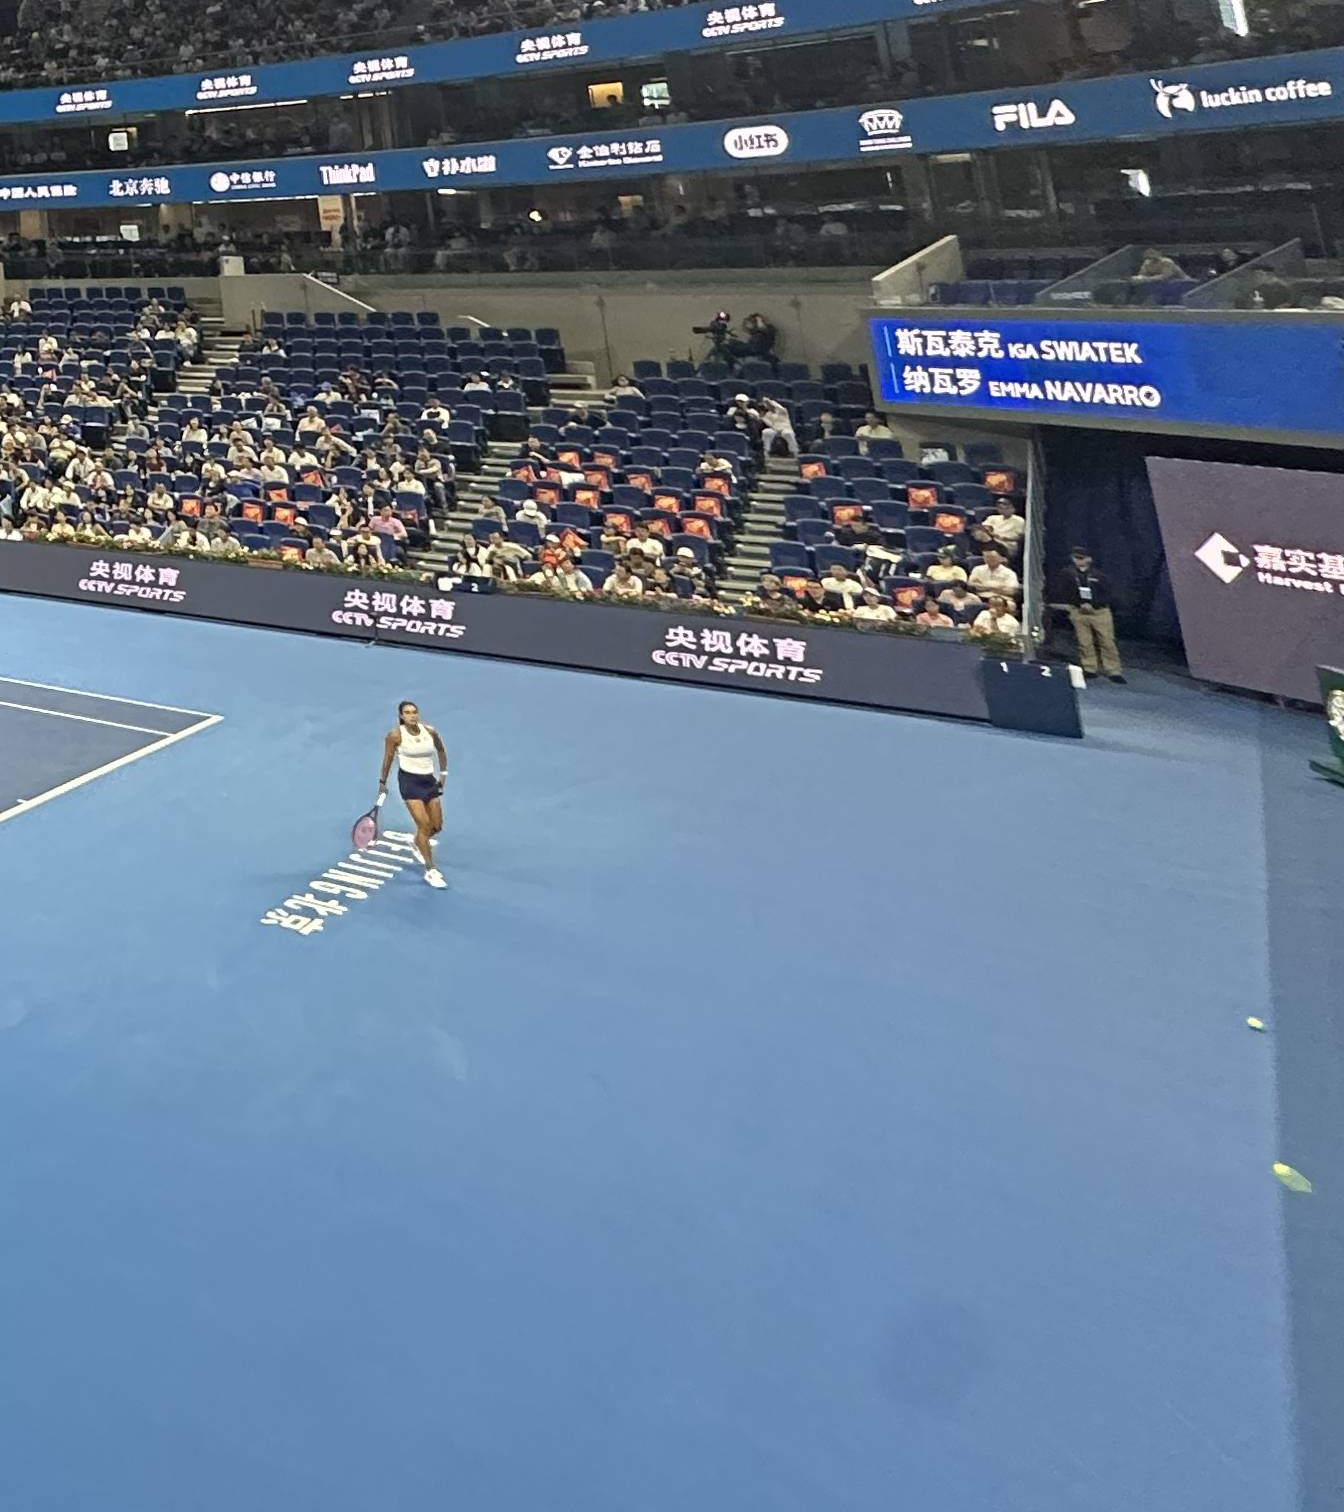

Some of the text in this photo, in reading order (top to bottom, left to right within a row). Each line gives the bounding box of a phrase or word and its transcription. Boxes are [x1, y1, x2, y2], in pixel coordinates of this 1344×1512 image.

[1200, 80, 1331, 107] luckin coffee
[992, 100, 1075, 131] FILA
[320, 163, 375, 184] ThinkPad
[896, 328, 1142, 365] 斯瓦泰克 IGA SWIATEK
[903, 367, 1162, 408] 纳瓦罗 EMMA NAVARRO
[90, 560, 180, 587] 央视体育
[471, 582, 479, 592] 2
[1257, 572, 1334, 594] Harvest
[78, 579, 187, 603] CCTV SPORTS
[344, 588, 456, 621] 央视体育
[331, 610, 467, 638] CCTV SPORTS
[665, 625, 807, 663] 央视体育
[651, 649, 823, 684] CCTV SPORTS
[1000, 662, 1052, 677] 1 2
